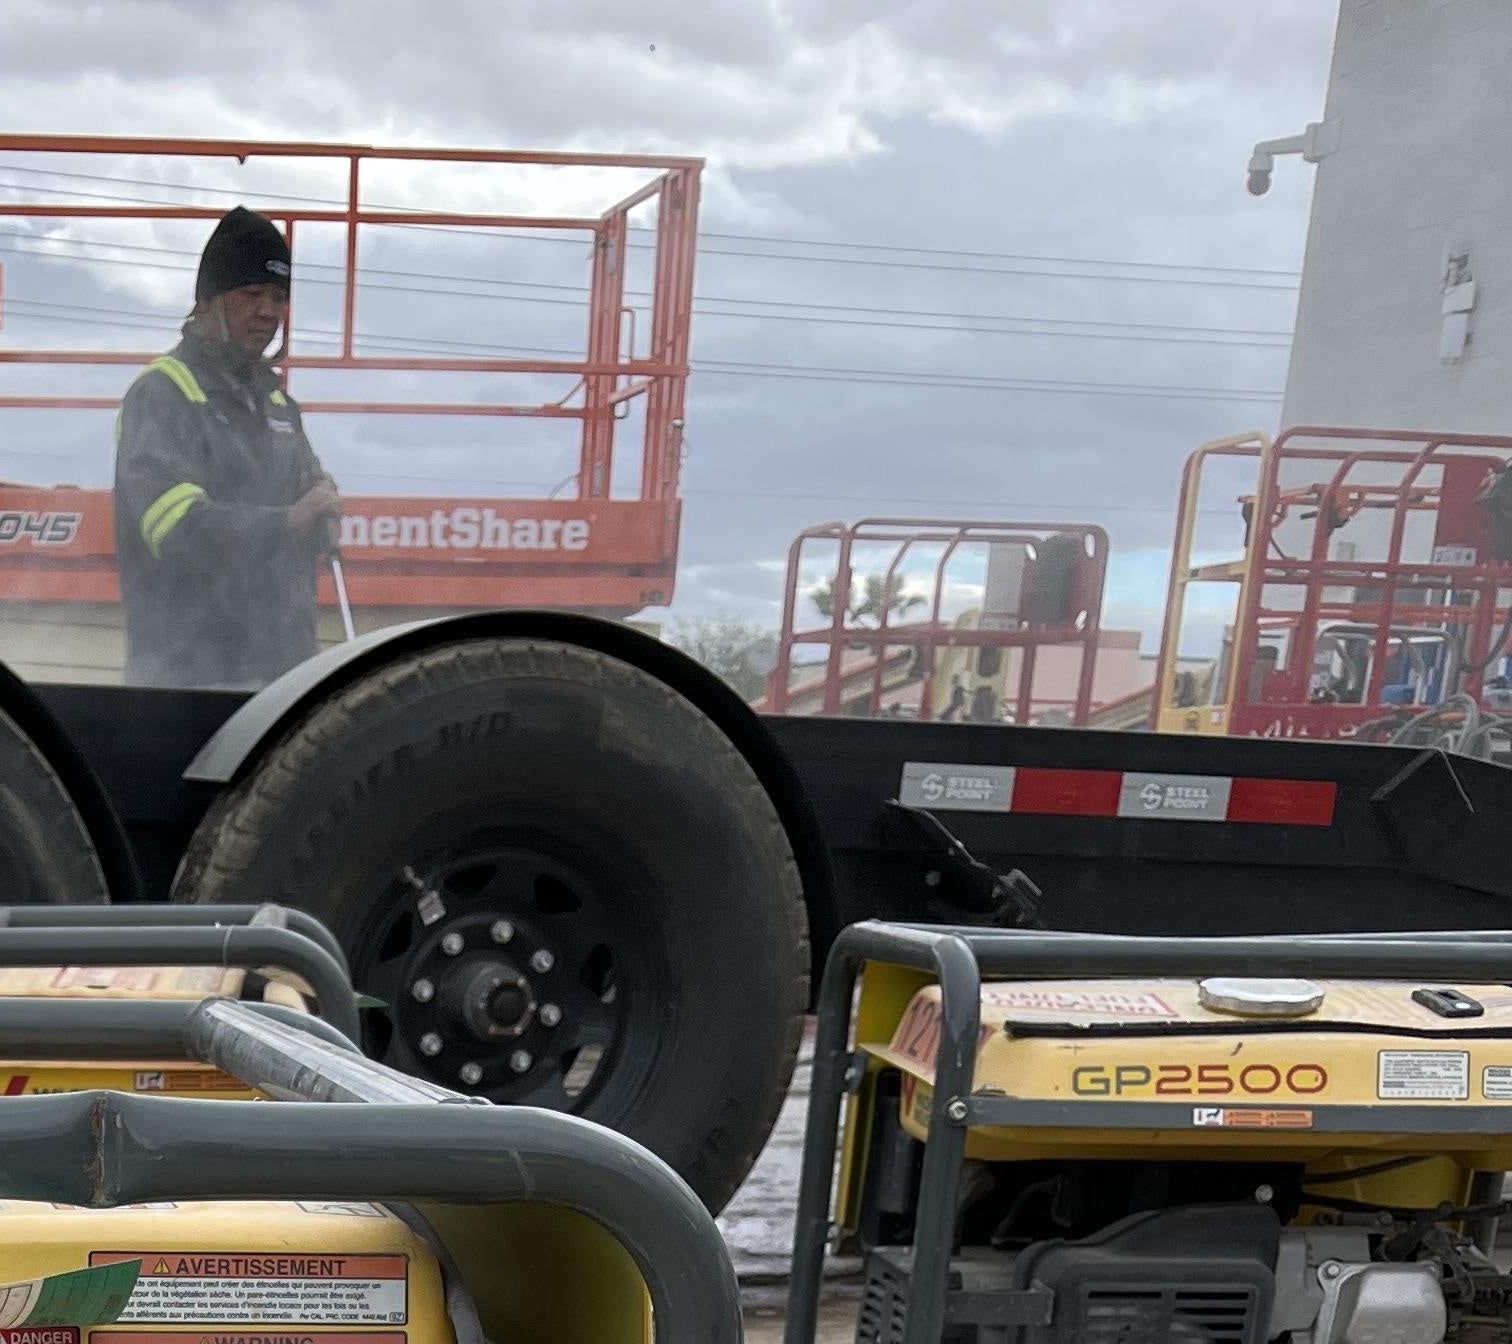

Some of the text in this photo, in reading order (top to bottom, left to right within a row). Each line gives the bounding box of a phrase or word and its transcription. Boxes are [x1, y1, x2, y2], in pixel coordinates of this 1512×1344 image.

[337, 508, 589, 551] mentShare
[1165, 786, 1209, 799] STEEL
[1072, 1064, 1328, 1095] GP2500
[176, 1259, 346, 1276] AVERTISSEMENT
